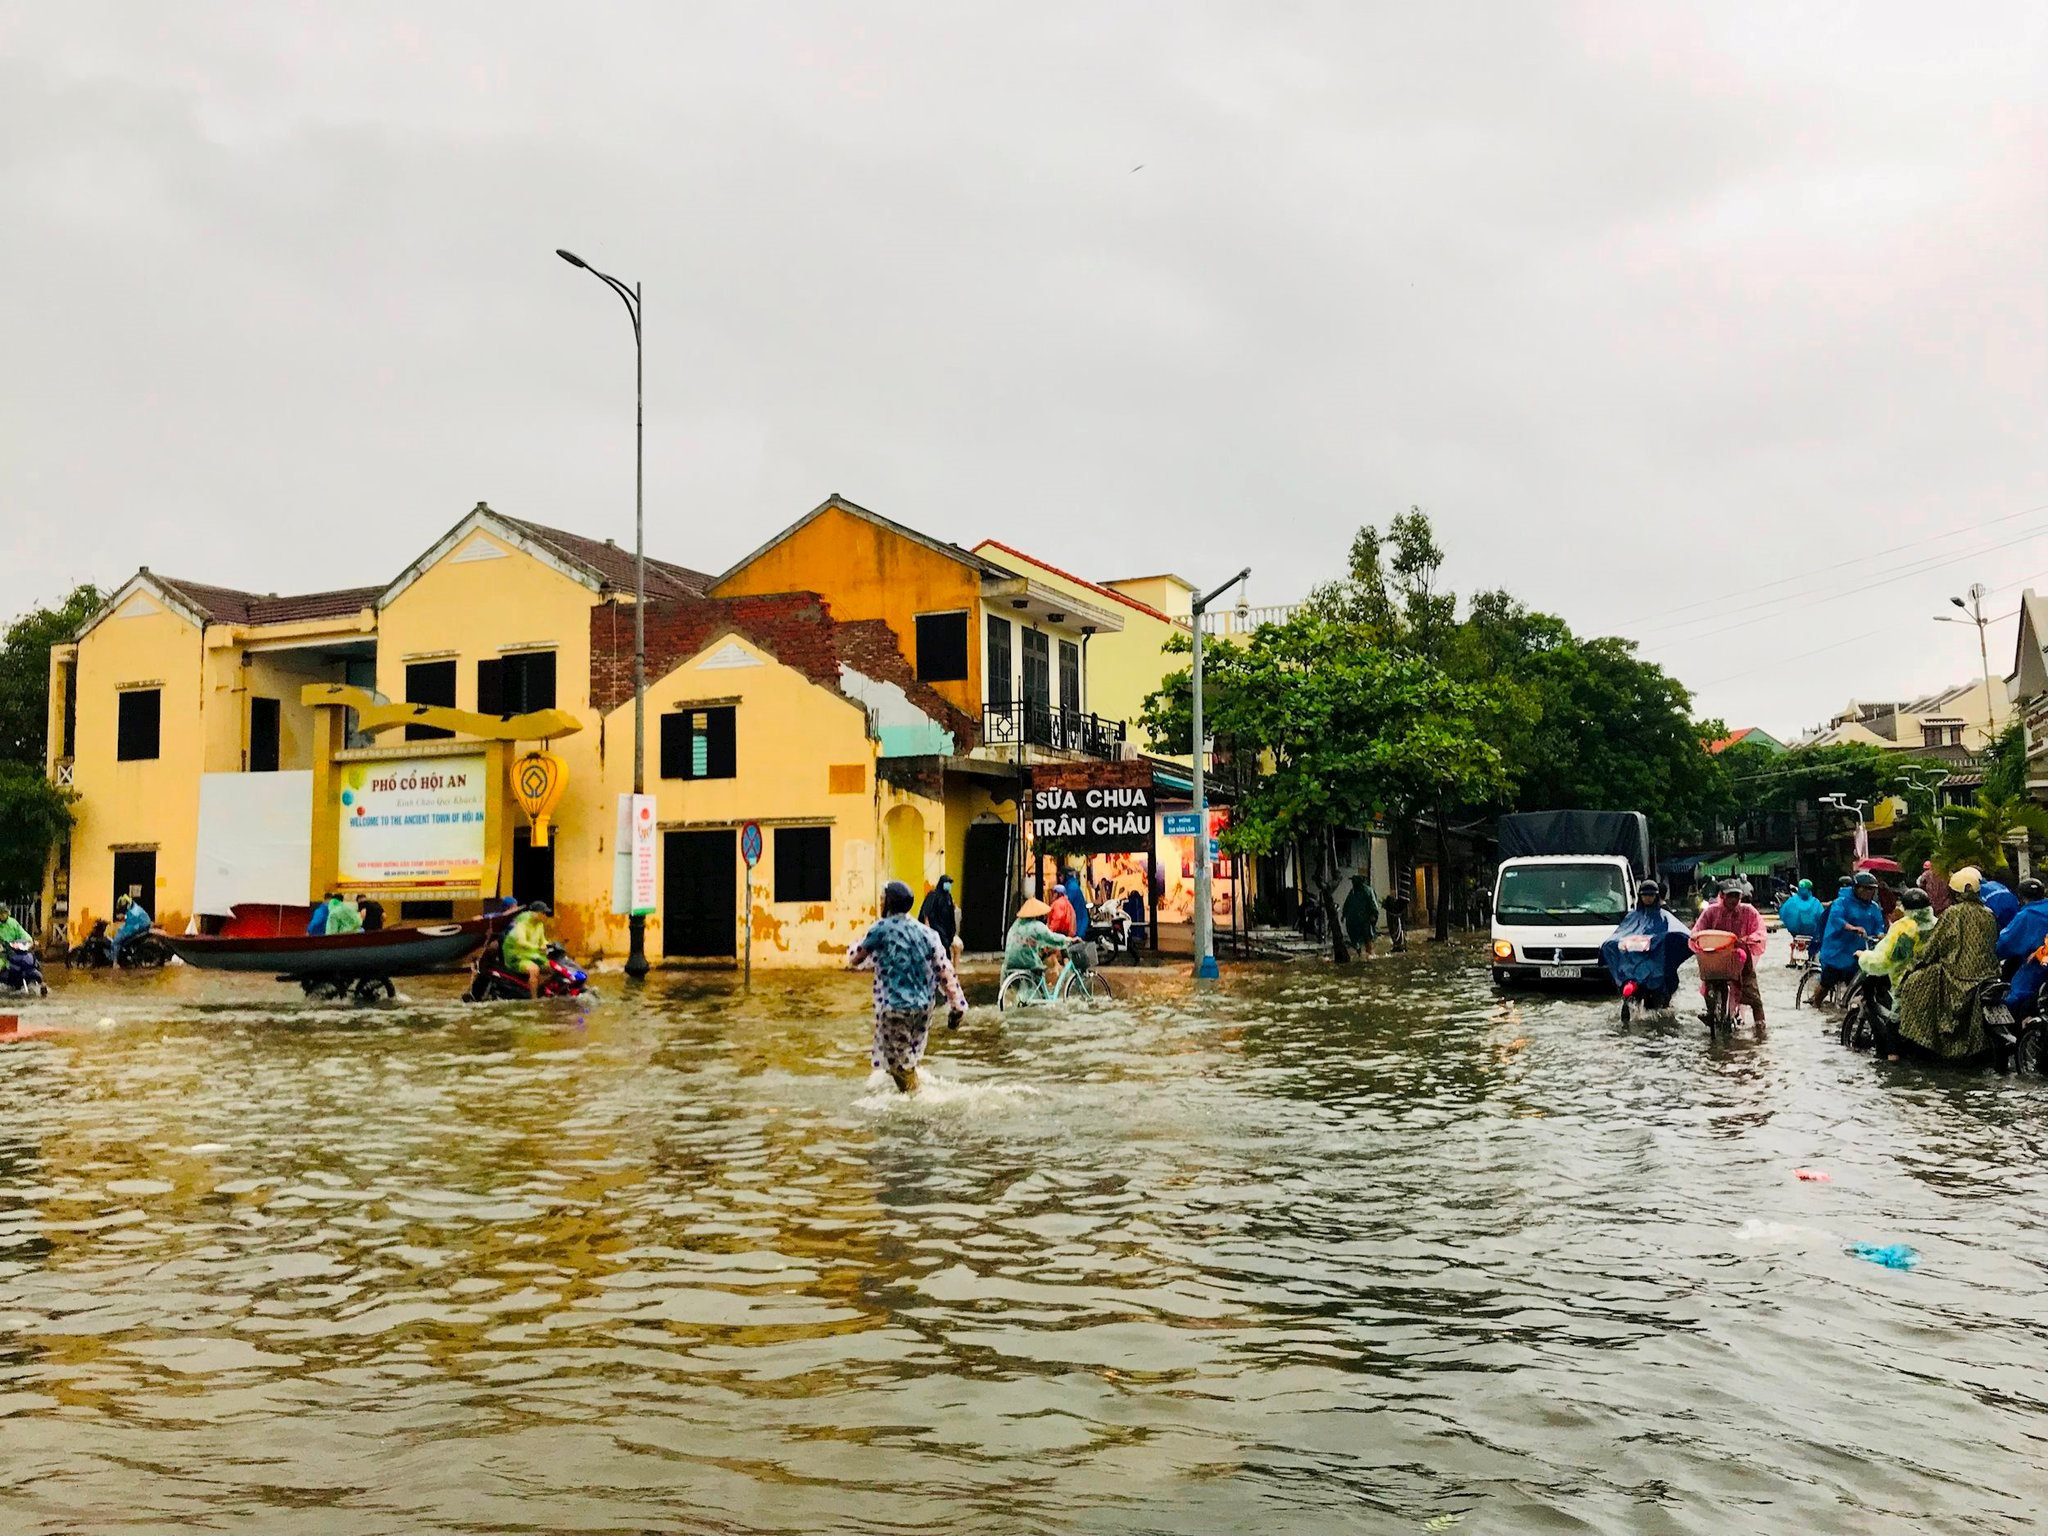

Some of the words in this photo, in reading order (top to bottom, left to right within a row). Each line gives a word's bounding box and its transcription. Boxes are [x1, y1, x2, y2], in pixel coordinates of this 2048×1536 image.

[372, 771, 397, 792] PHỐ
[400, 769, 417, 790] CỔ
[420, 772, 443, 792] HỘI
[447, 774, 467, 788] AN
[1035, 786, 1078, 810] SỮA
[1085, 788, 1148, 808] CHUA
[350, 815, 379, 828] WELCOME
[381, 815, 389, 826] TO
[390, 815, 403, 826] THE
[404, 814, 430, 825] ANCIENT
[432, 813, 450, 824] TOWN
[451, 812, 461, 822] OF
[475, 811, 484, 821] AN
[1033, 813, 1086, 837] TRÂN
[1091, 811, 1151, 835] CHÂU
